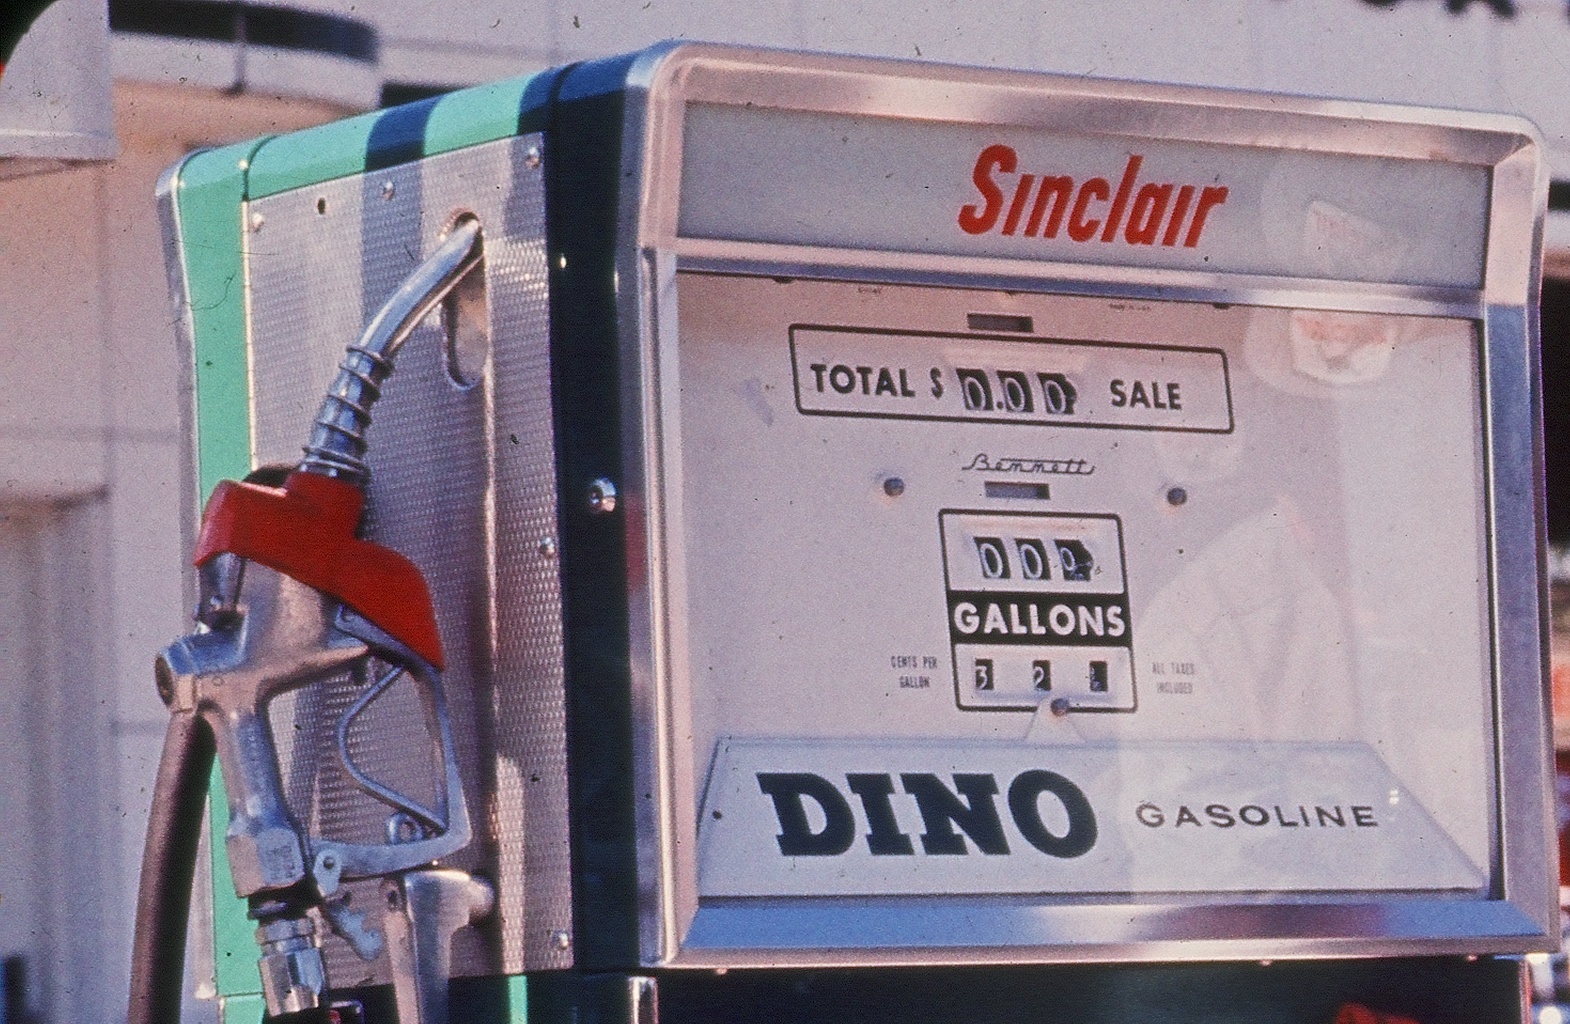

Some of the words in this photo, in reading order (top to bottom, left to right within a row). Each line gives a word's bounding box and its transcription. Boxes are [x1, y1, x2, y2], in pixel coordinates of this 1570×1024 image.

[957, 144, 1229, 248] Sinclair
[810, 363, 915, 398] TOTAL
[1109, 379, 1182, 410] SALE
[961, 453, 1096, 475] Bennett
[953, 601, 1126, 637] GALLONS
[890, 655, 918, 669] CENTS
[922, 656, 938, 670] PER
[899, 676, 931, 689] GALLON
[755, 768, 1099, 859] DINO
[1134, 801, 1378, 829] GASOLINE
